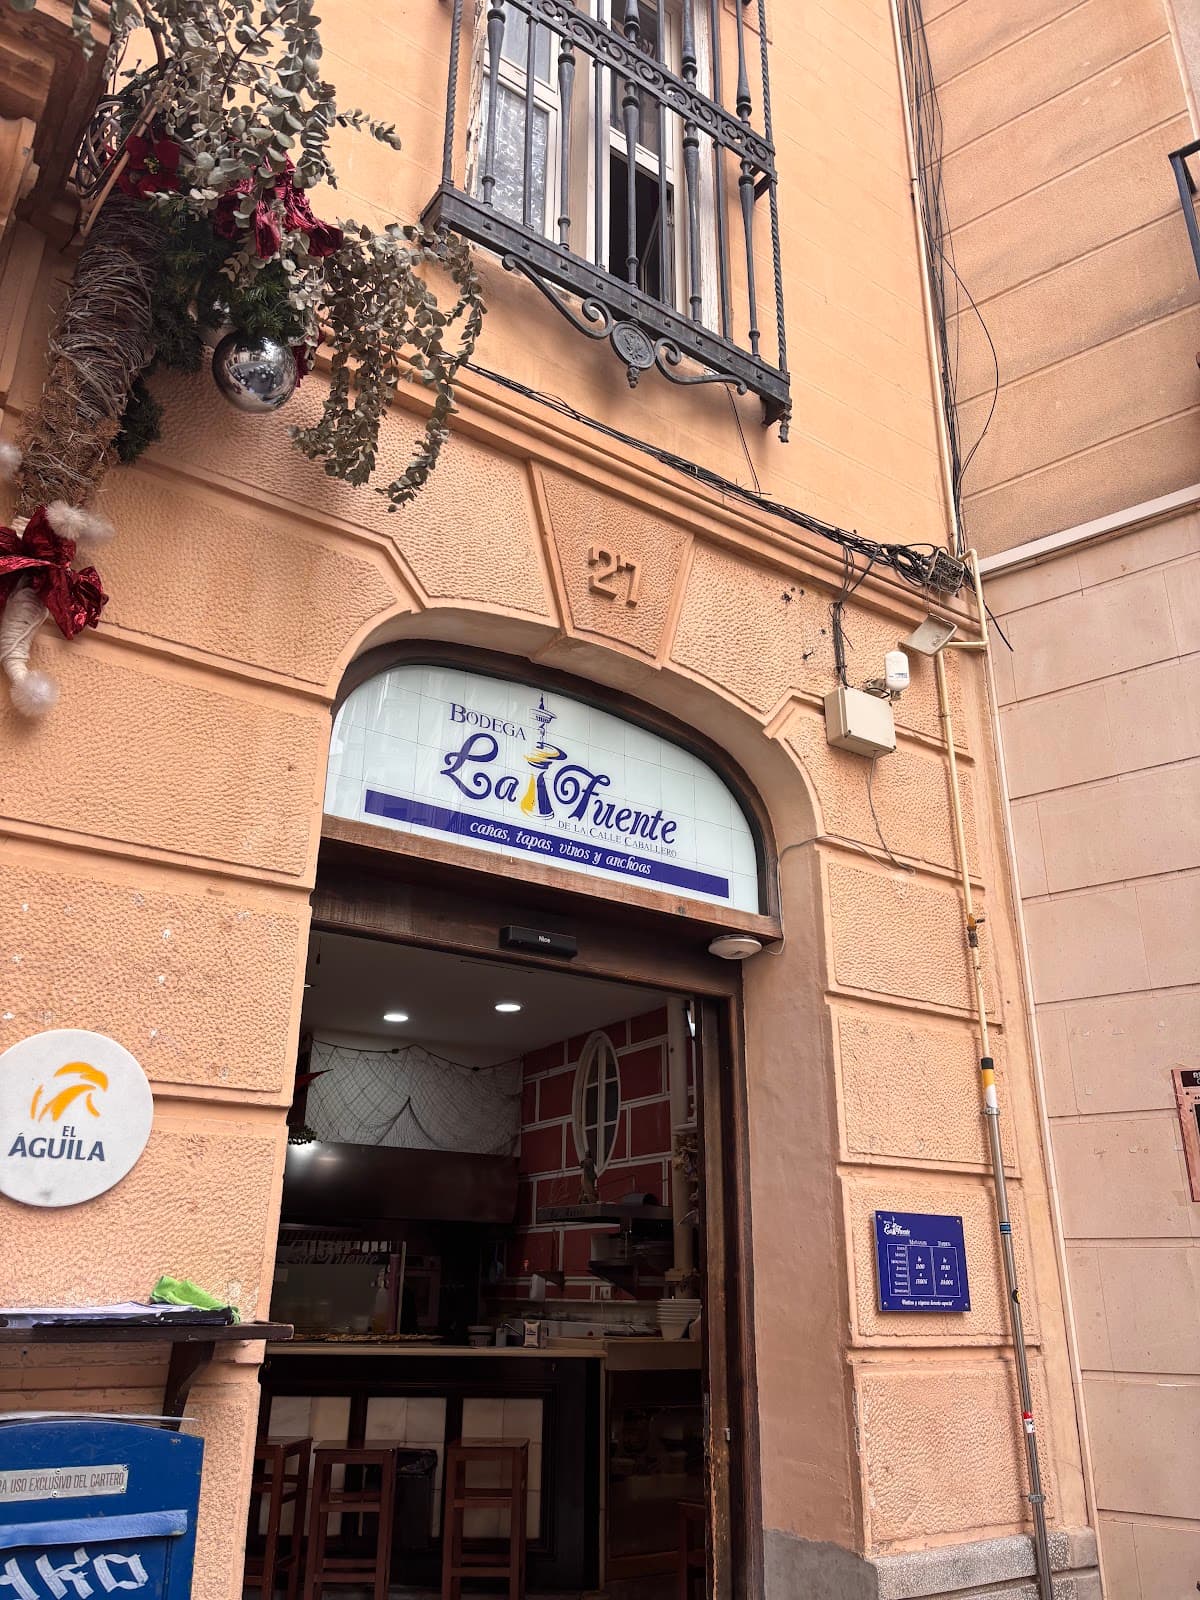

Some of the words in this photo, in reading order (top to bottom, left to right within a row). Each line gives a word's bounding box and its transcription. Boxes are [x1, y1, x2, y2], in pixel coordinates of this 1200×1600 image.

[587, 544, 641, 608] 27
[440, 732, 520, 802] La
[553, 764, 678, 845] Fuente
[558, 820, 571, 830] DE
[574, 824, 587, 835] LA
[515, 831, 554, 853] tapas,
[559, 842, 591, 860] vinos
[592, 852, 602, 865] y
[605, 855, 653, 875] anchoas
[62, 1125, 77, 1138] EL
[8, 1132, 105, 1161] ÁGUILA
[10, 1478, 28, 1493] USO
[29, 1474, 72, 1492] EXCLUSIVO
[73, 1473, 88, 1489] DEL
[90, 1471, 125, 1488] CARTERO
